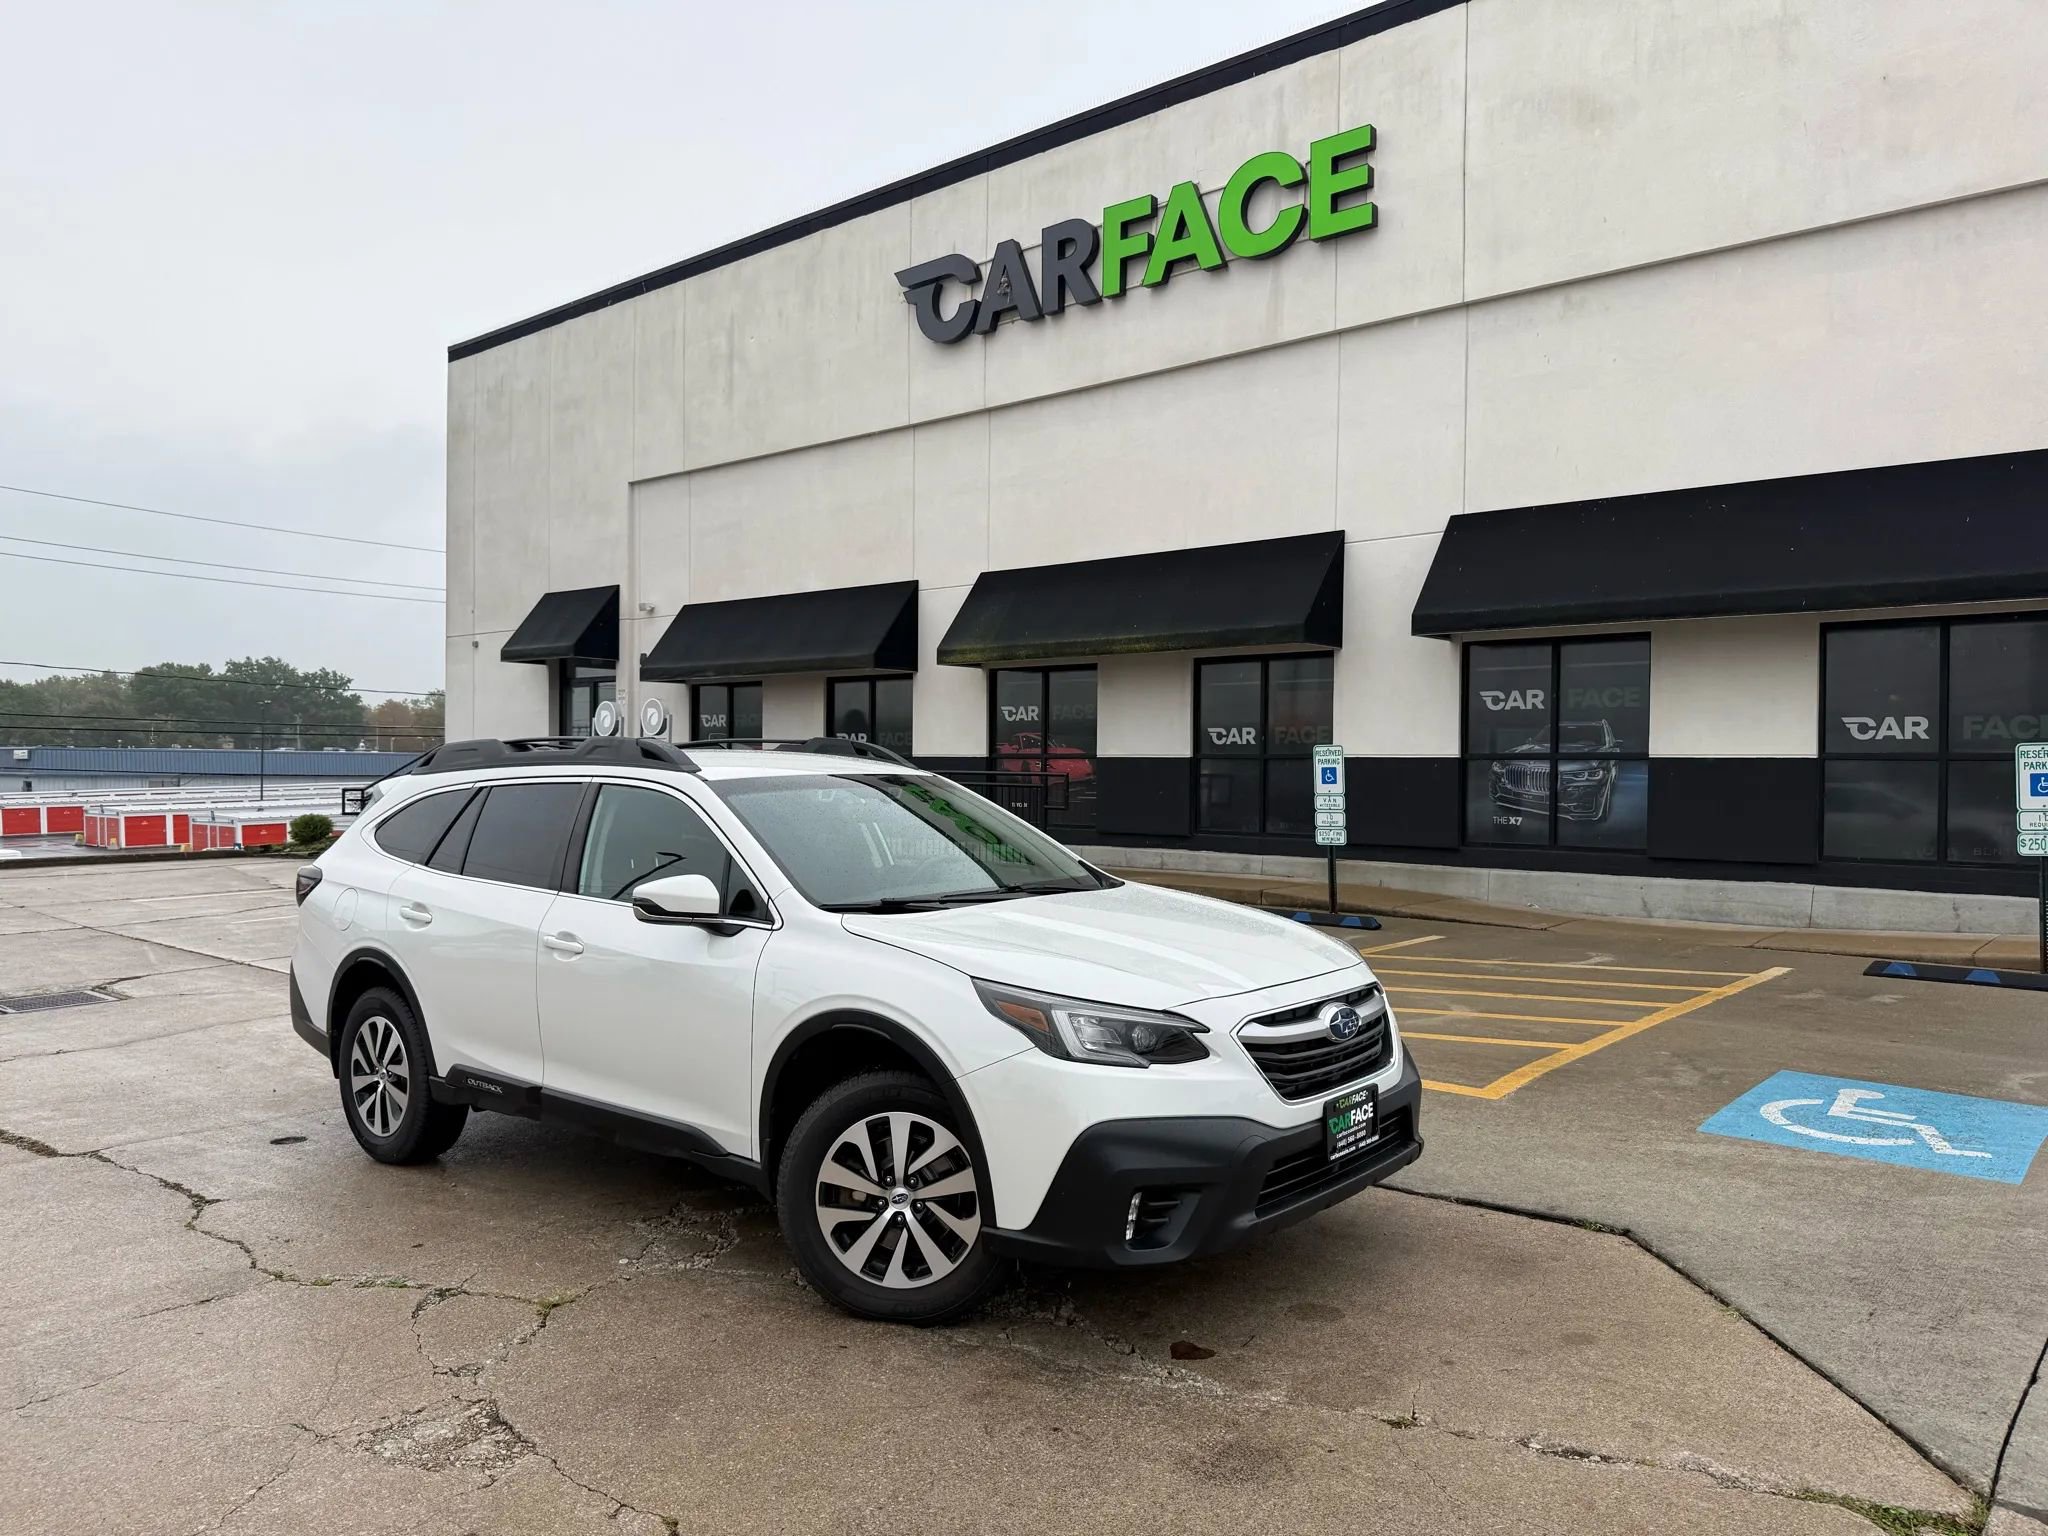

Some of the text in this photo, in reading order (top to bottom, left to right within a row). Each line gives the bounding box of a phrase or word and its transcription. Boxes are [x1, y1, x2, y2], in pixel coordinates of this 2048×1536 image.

[895, 124, 1378, 344] CARFACE
[1480, 686, 1641, 711] CAR FACE
[701, 714, 726, 728] CAR
[1001, 705, 1039, 721] CAR
[1207, 727, 1256, 745] CAR
[1841, 716, 1930, 741] CAR
[1316, 749, 1341, 757] RESERVED
[2020, 750, 2048, 759] RESER
[1317, 758, 1340, 766] PARKING
[2023, 760, 2048, 770] PARK
[1492, 815, 1523, 826] THE X7
[467, 1078, 503, 1094] OUTBACK
[1328, 1101, 1374, 1134] CARFACE
